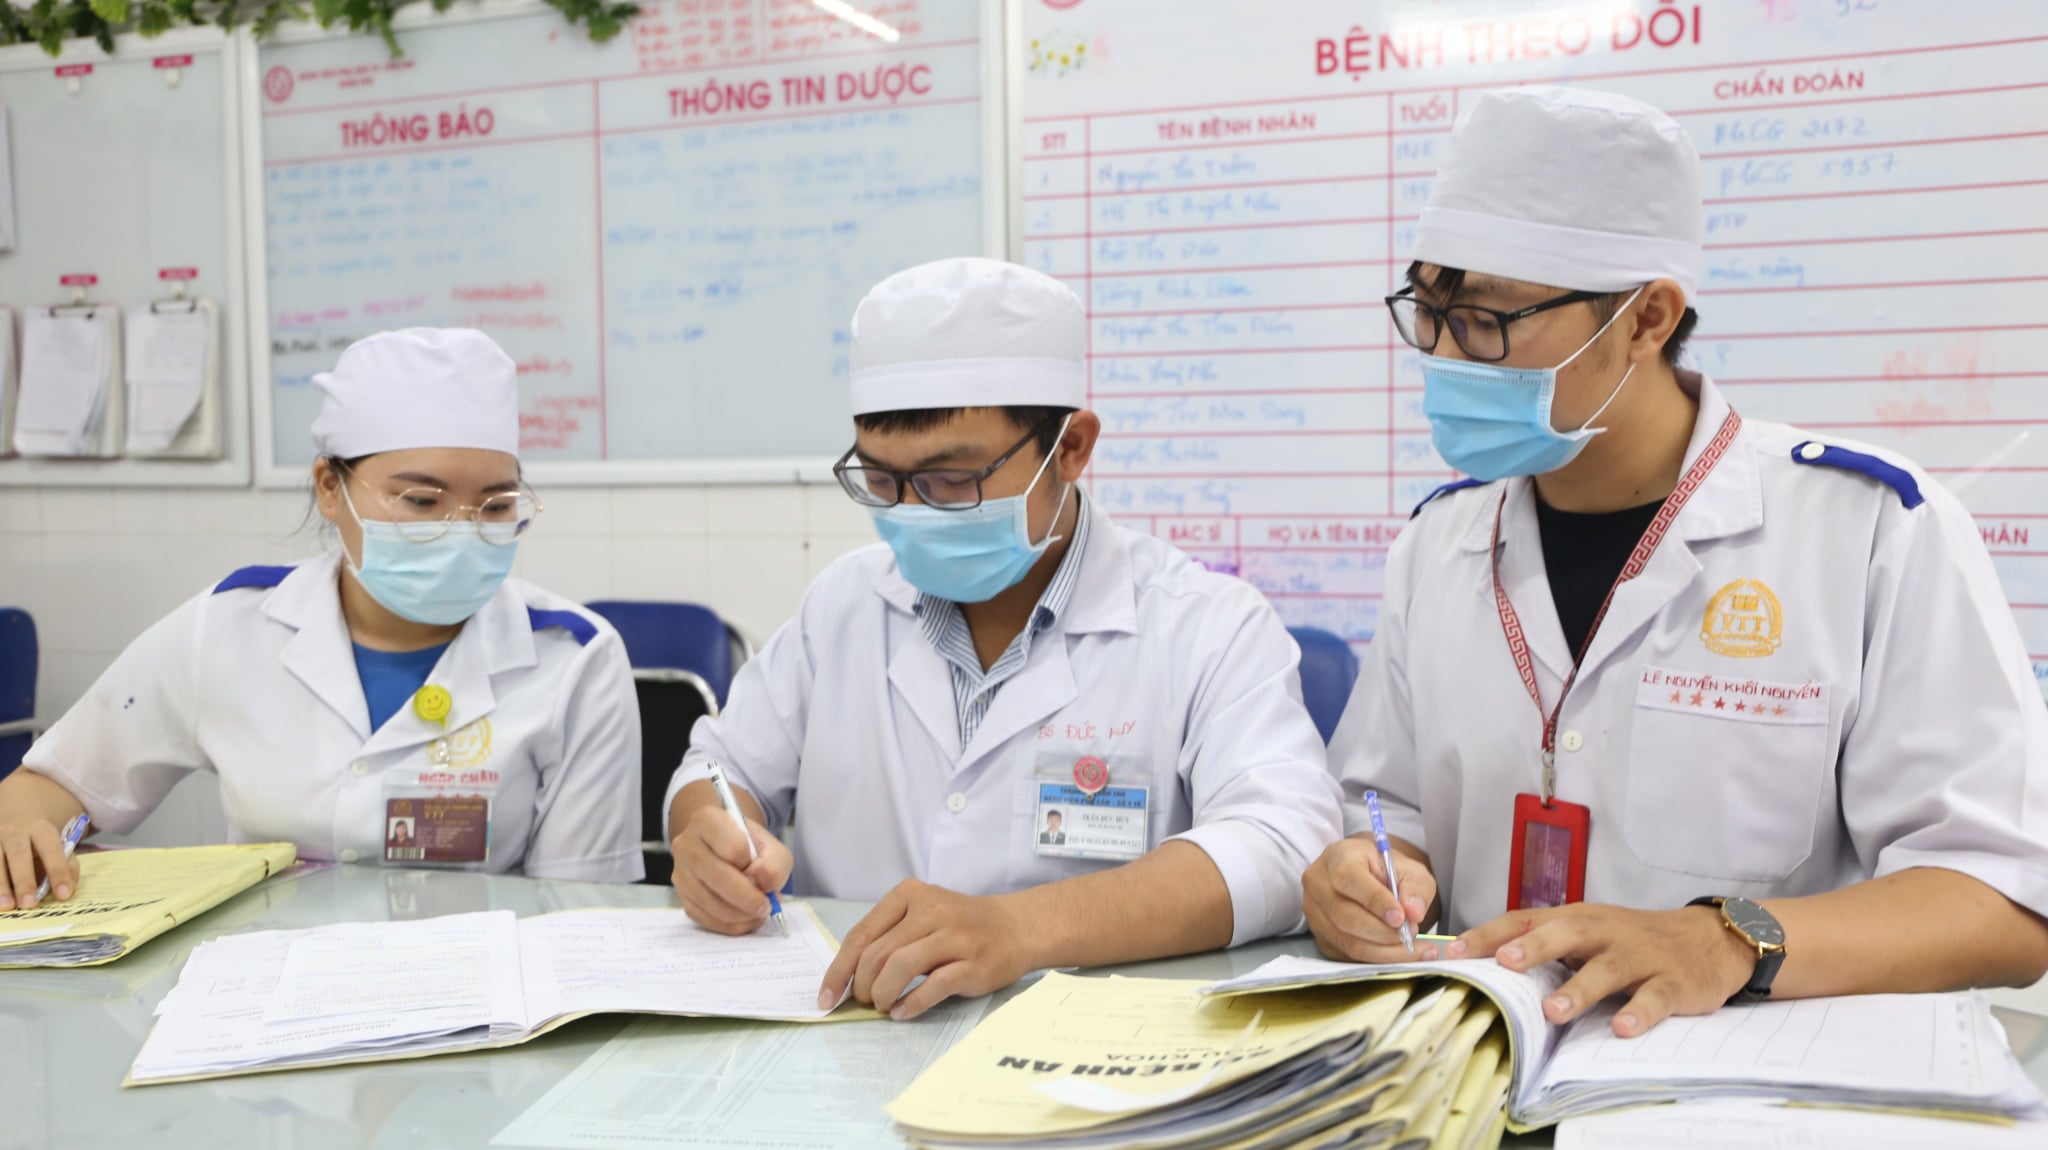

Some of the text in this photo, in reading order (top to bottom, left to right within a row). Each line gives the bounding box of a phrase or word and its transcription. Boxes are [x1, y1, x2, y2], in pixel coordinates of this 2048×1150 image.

[1316, 25, 1443, 83] BỆNH
[1465, 16, 1591, 64] THEO
[667, 61, 932, 118] THÔNG TIN DƯỢC
[341, 101, 495, 147] THÔNG BÁO
[1157, 119, 1193, 140] TÊN
[1041, 132, 1067, 150] STT
[1170, 522, 1205, 542] BÁC
[1268, 527, 1293, 544] HỌ
[1326, 522, 1358, 542] TÊN
[1363, 524, 1402, 545] BỆN
[1977, 527, 2029, 546] HÂN
[1720, 612, 1767, 632] VTT
